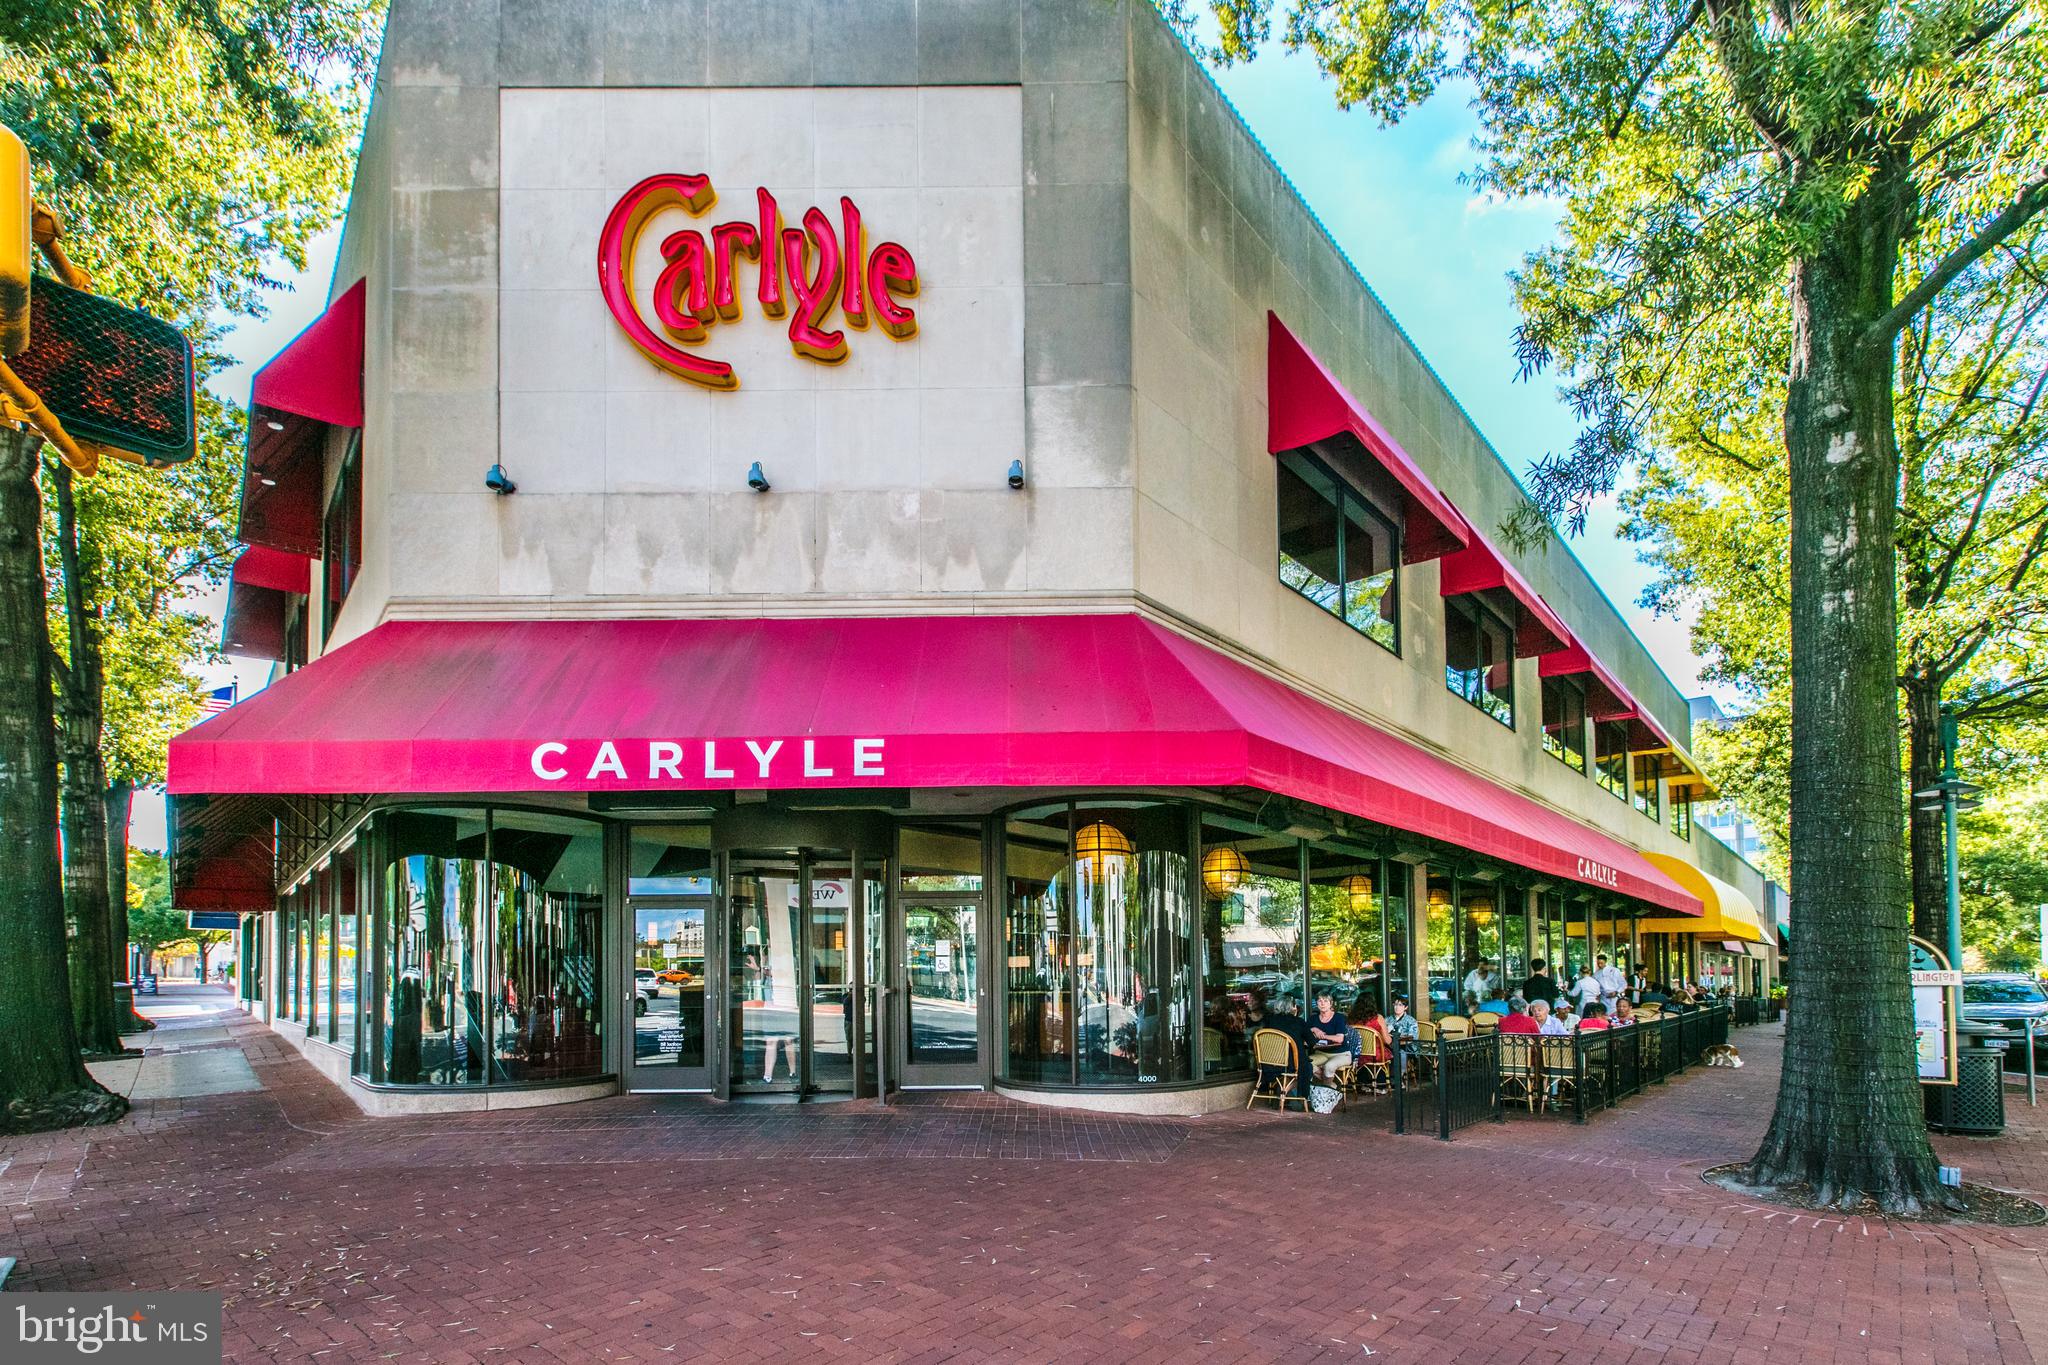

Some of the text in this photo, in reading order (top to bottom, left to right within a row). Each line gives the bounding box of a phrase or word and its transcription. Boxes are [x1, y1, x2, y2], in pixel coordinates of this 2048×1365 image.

[597, 173, 920, 391] Carlyle
[531, 738, 885, 780] CARLYLE
[1577, 857, 1618, 887] CARLYLE
[1911, 972, 1955, 982] RLINGTON
[1138, 1075, 1157, 1083] 4000
